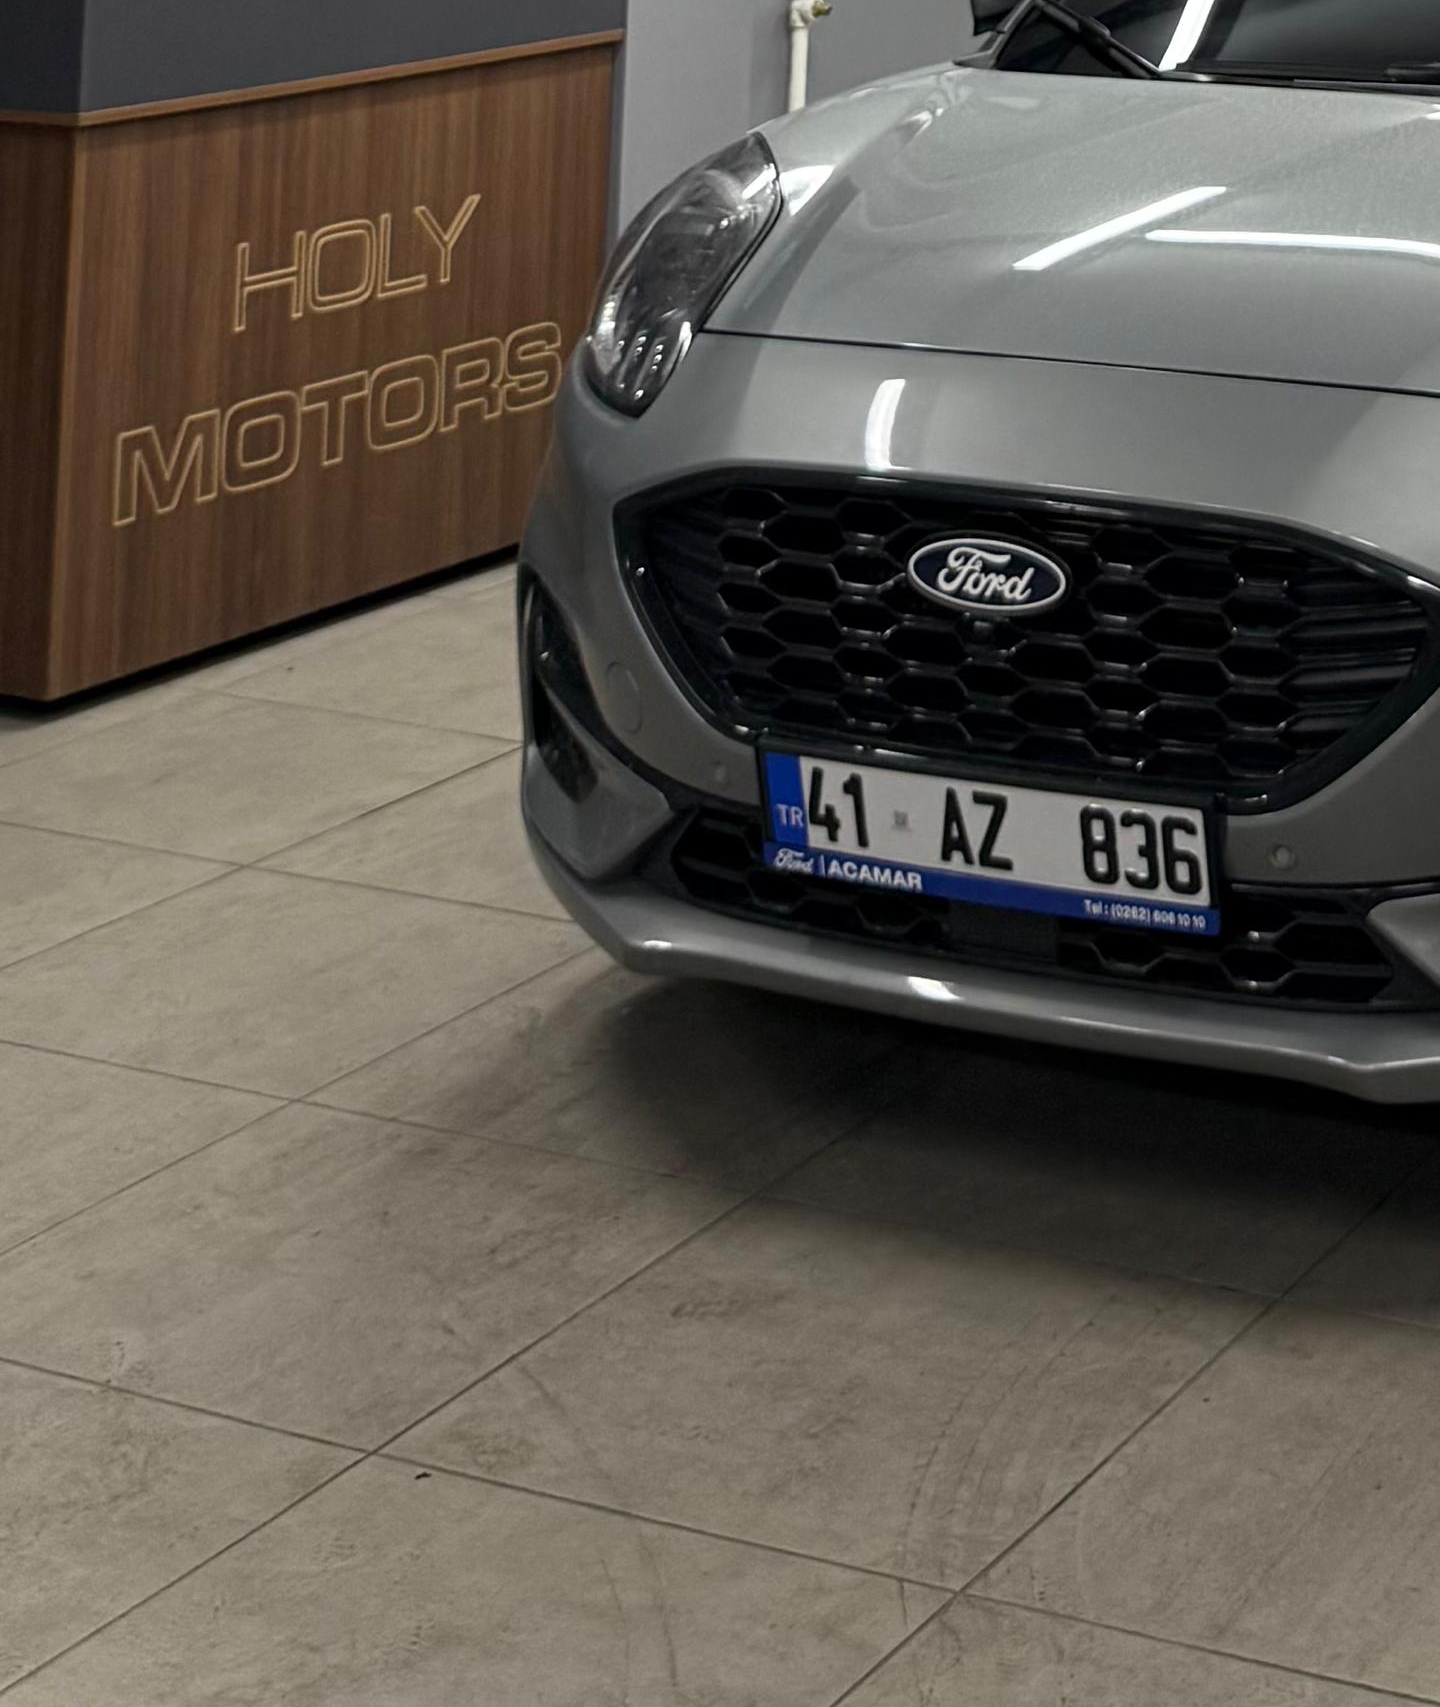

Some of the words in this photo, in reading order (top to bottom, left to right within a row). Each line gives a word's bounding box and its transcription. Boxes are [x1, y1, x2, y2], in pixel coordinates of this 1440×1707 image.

[231, 193, 481, 333] HOLY
[113, 321, 563, 526] MOTORS
[937, 546, 1036, 601] Ford
[776, 803, 804, 828] TR
[809, 766, 870, 848] 41
[940, 786, 1014, 871] AZ
[1080, 803, 1202, 895] 836
[774, 847, 814, 874] Ford
[828, 858, 924, 891] ACAMAR
